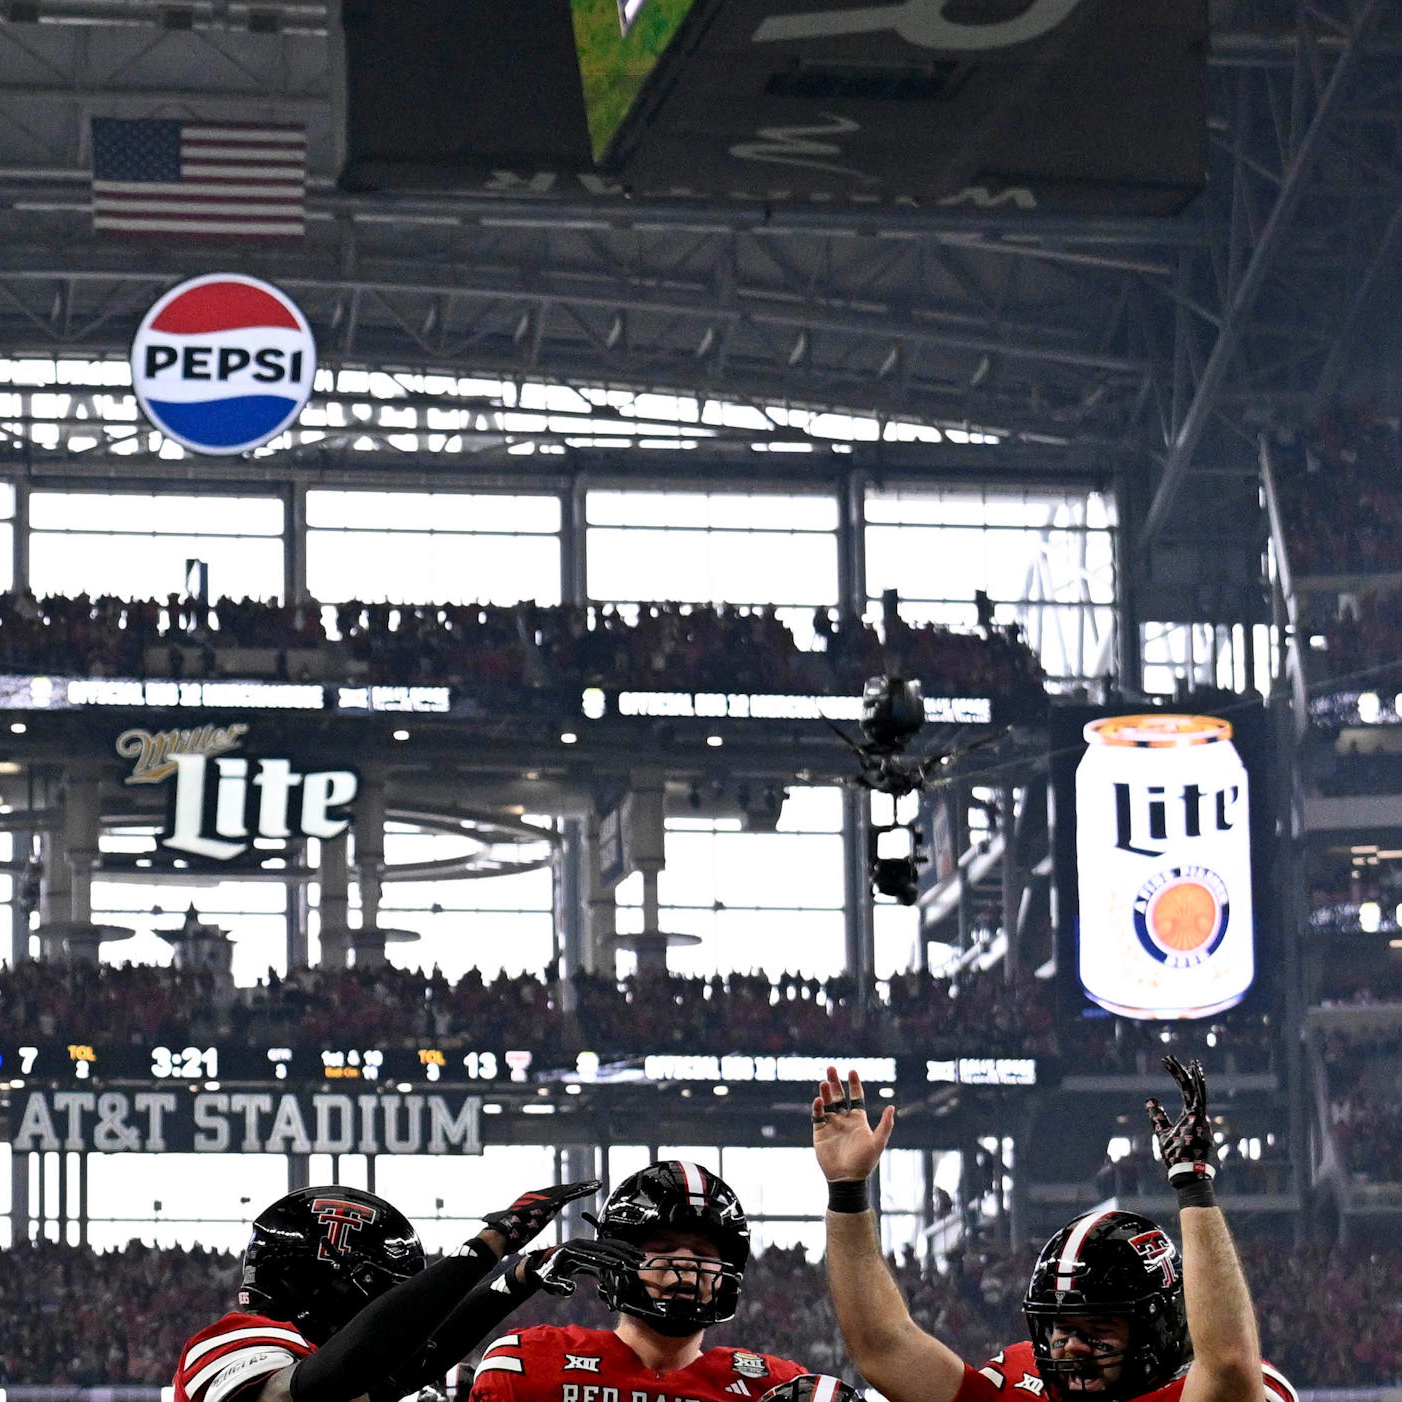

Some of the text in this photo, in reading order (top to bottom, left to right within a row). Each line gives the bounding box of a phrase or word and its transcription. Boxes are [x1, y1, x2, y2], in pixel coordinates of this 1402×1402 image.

[144, 344, 304, 384] PEPSI
[116, 723, 250, 784] Miller
[162, 753, 359, 860] Lite
[1112, 782, 1239, 858] Lite
[18, 1047, 38, 1074] 7
[151, 1046, 219, 1078] 3:21
[463, 1051, 498, 1080] 13
[13, 1091, 484, 1156] AT&T STADIUM
[564, 1353, 601, 1373] XII
